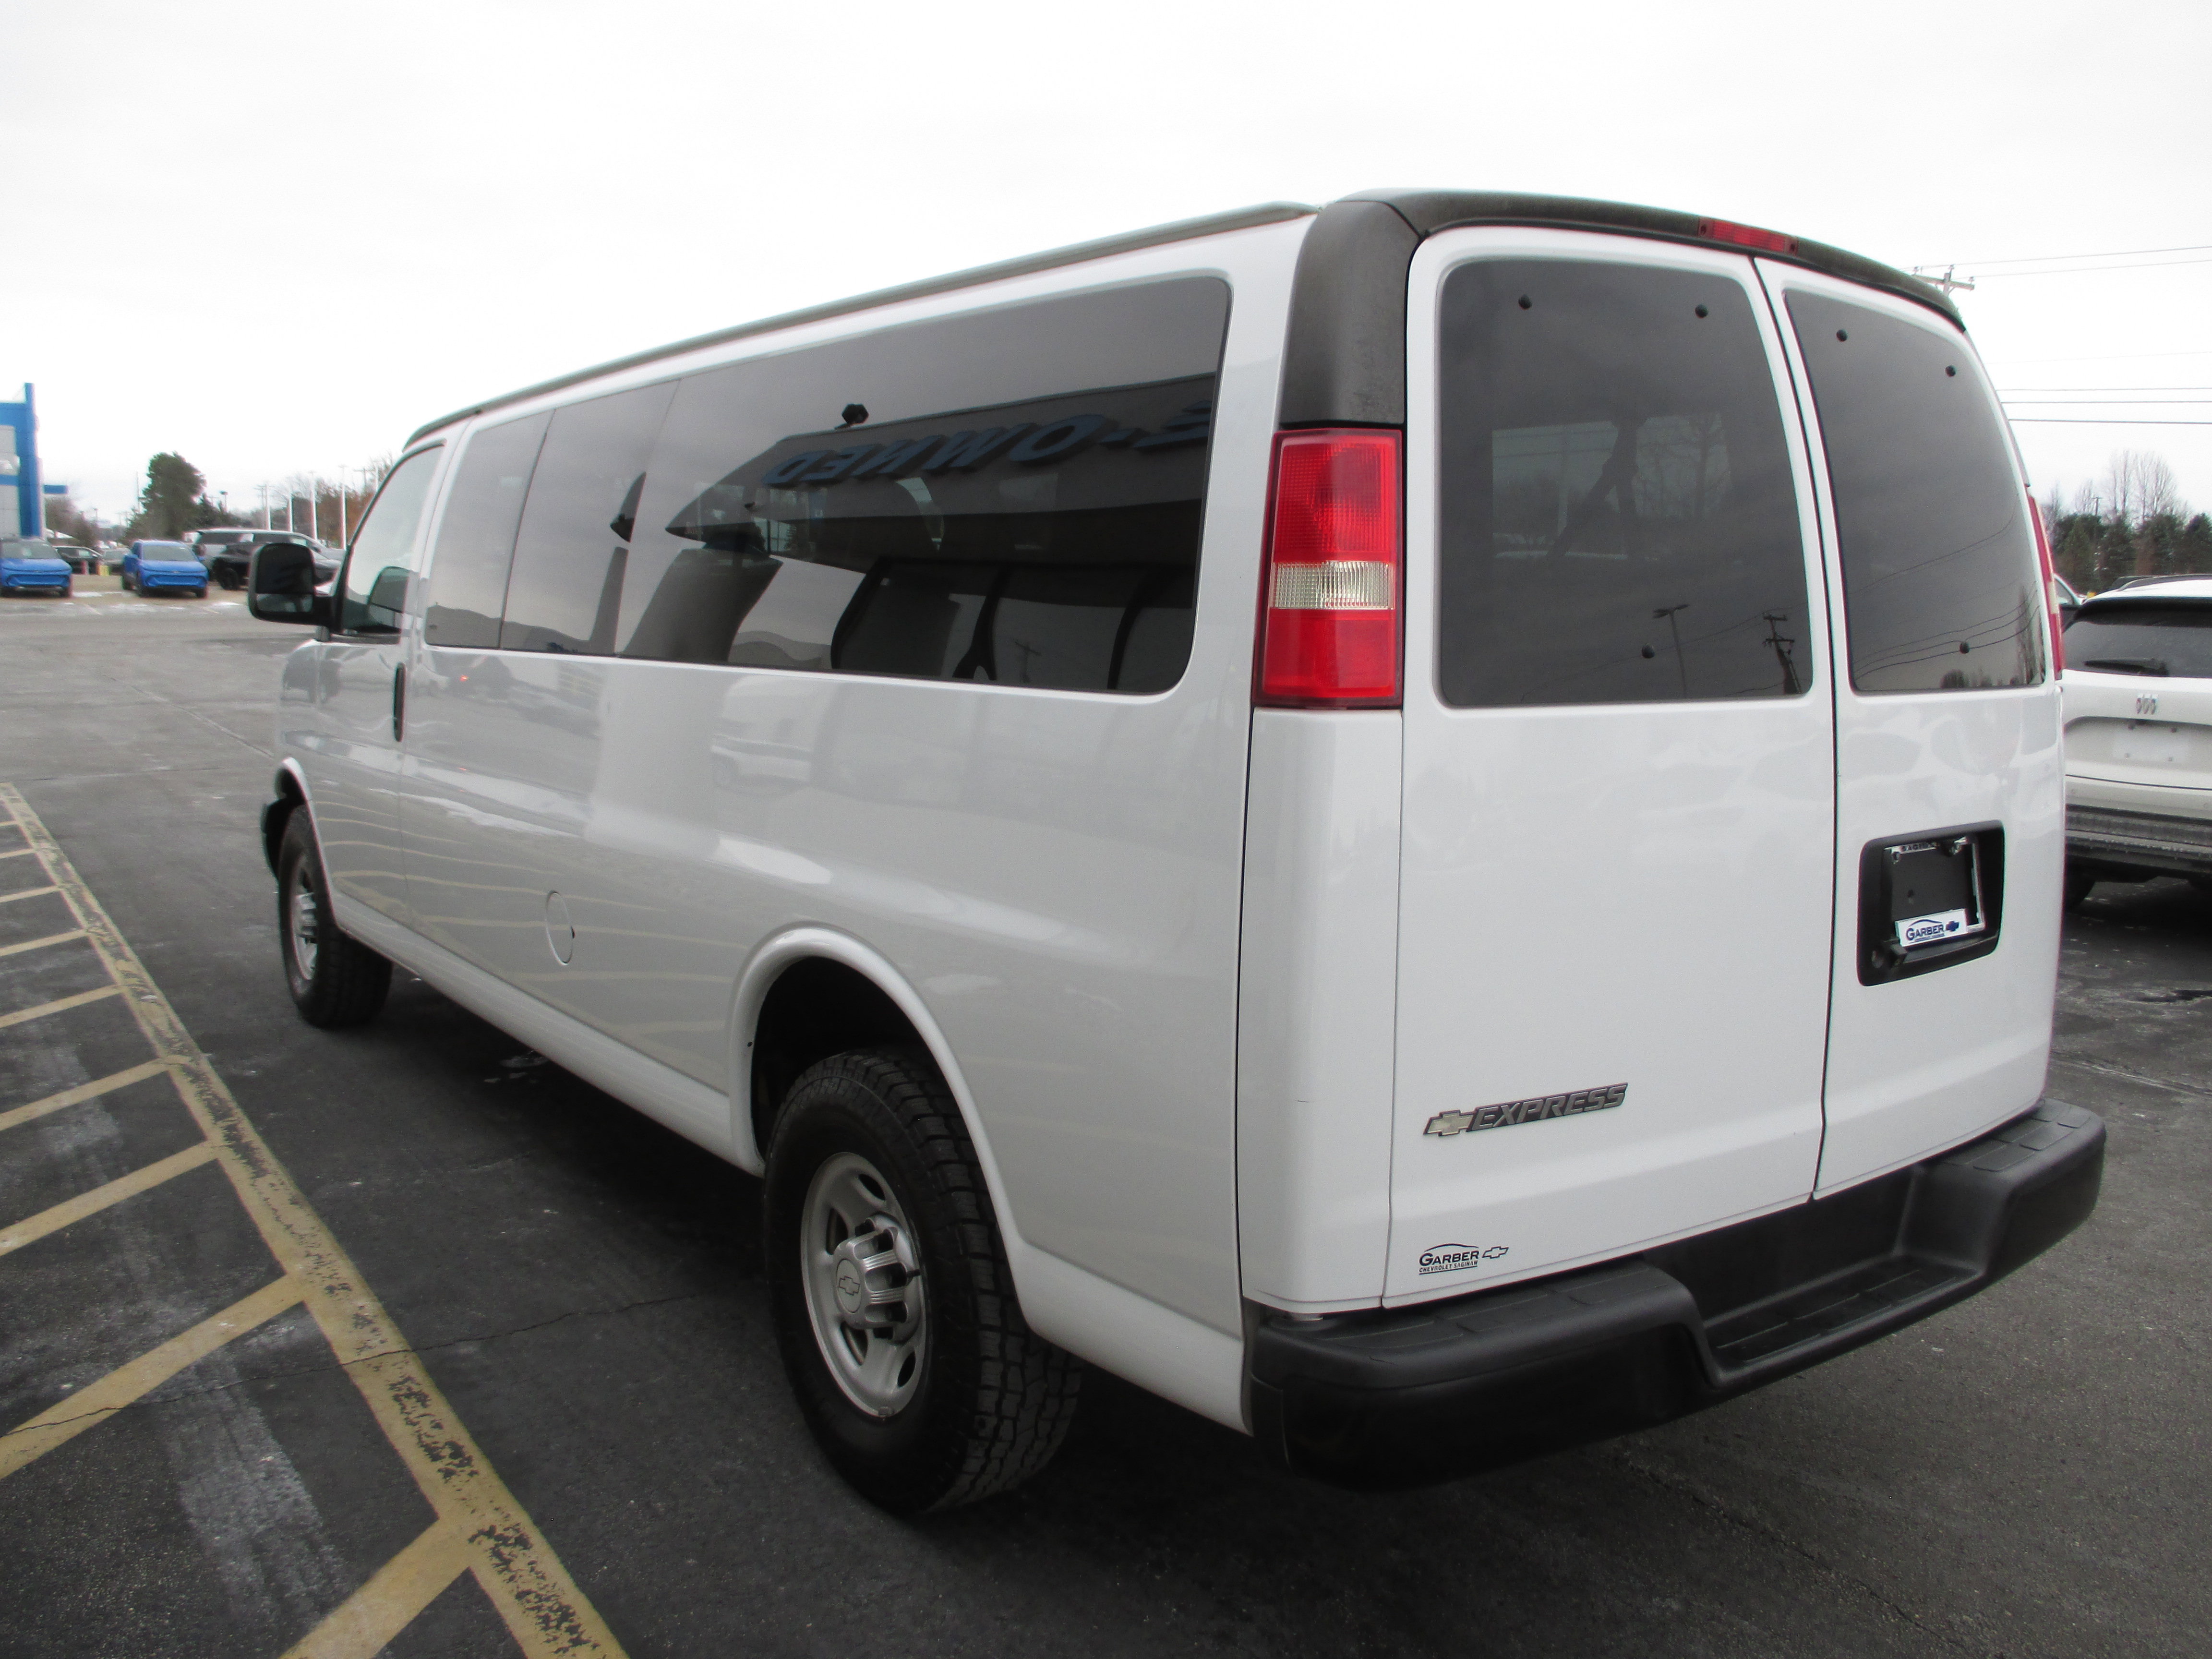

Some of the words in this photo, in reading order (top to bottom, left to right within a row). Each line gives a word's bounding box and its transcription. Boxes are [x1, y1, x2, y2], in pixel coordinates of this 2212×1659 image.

[1906, 924, 1944, 940] GARBER
[1471, 1083, 1627, 1130] EXPRESS
[1419, 1250, 1479, 1266] GARBER
[1419, 1264, 1453, 1273] CHEVROLET
[1453, 1260, 1478, 1269] SAGINAW
